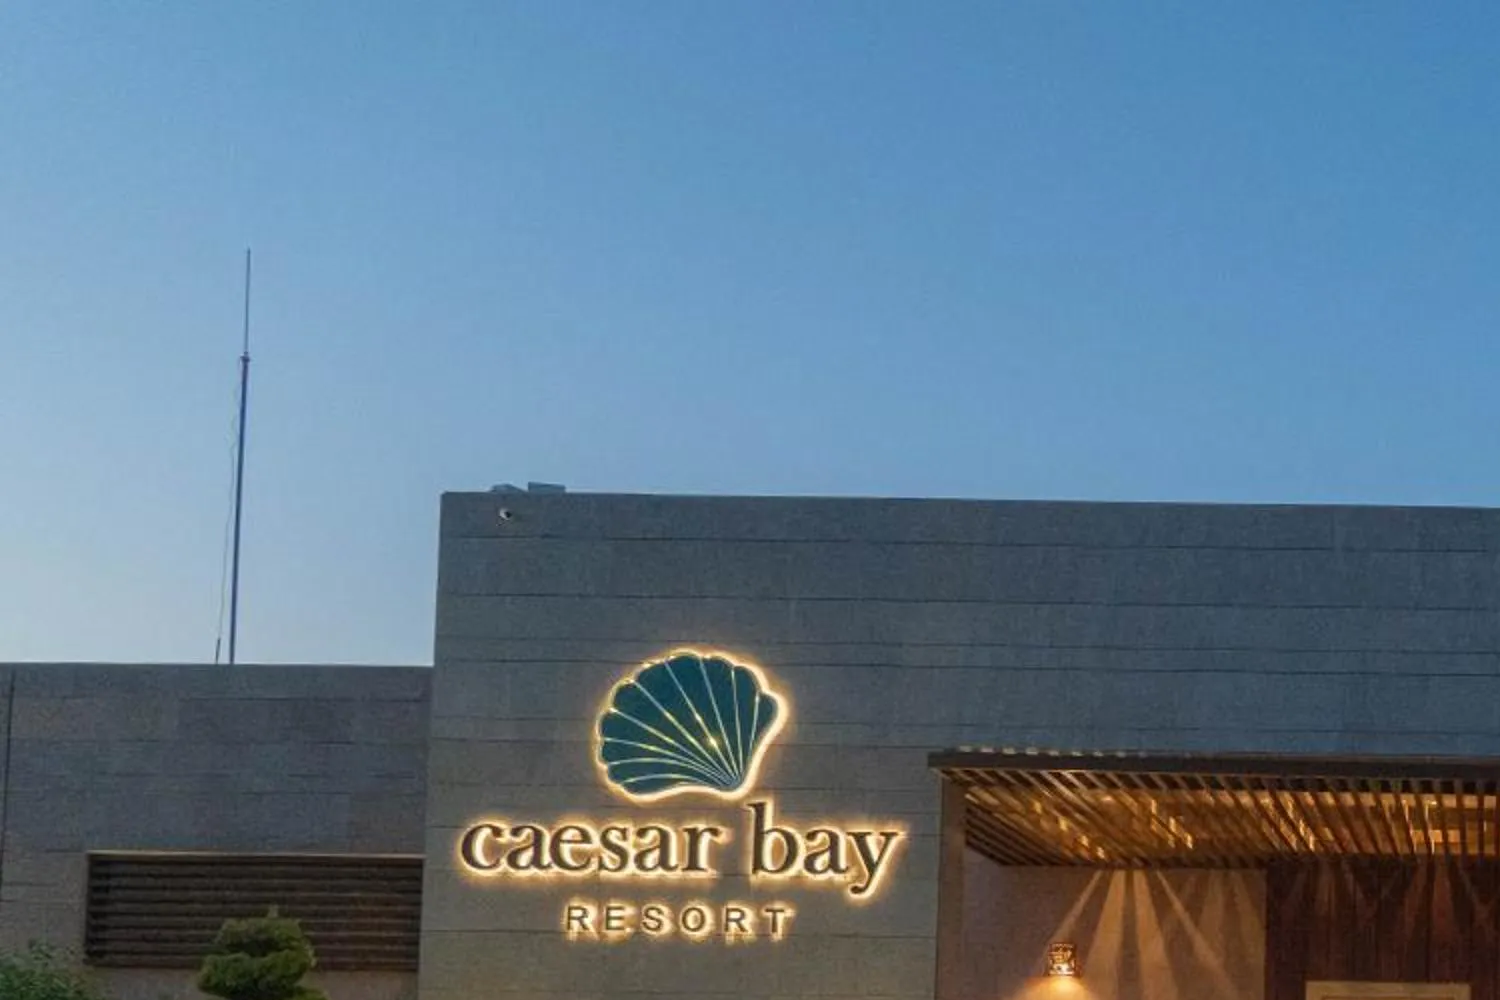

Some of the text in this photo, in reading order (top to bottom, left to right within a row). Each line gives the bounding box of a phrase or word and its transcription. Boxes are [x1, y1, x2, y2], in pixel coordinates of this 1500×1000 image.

[459, 801, 900, 896] caesar bay
[564, 905, 791, 934] RESORT
